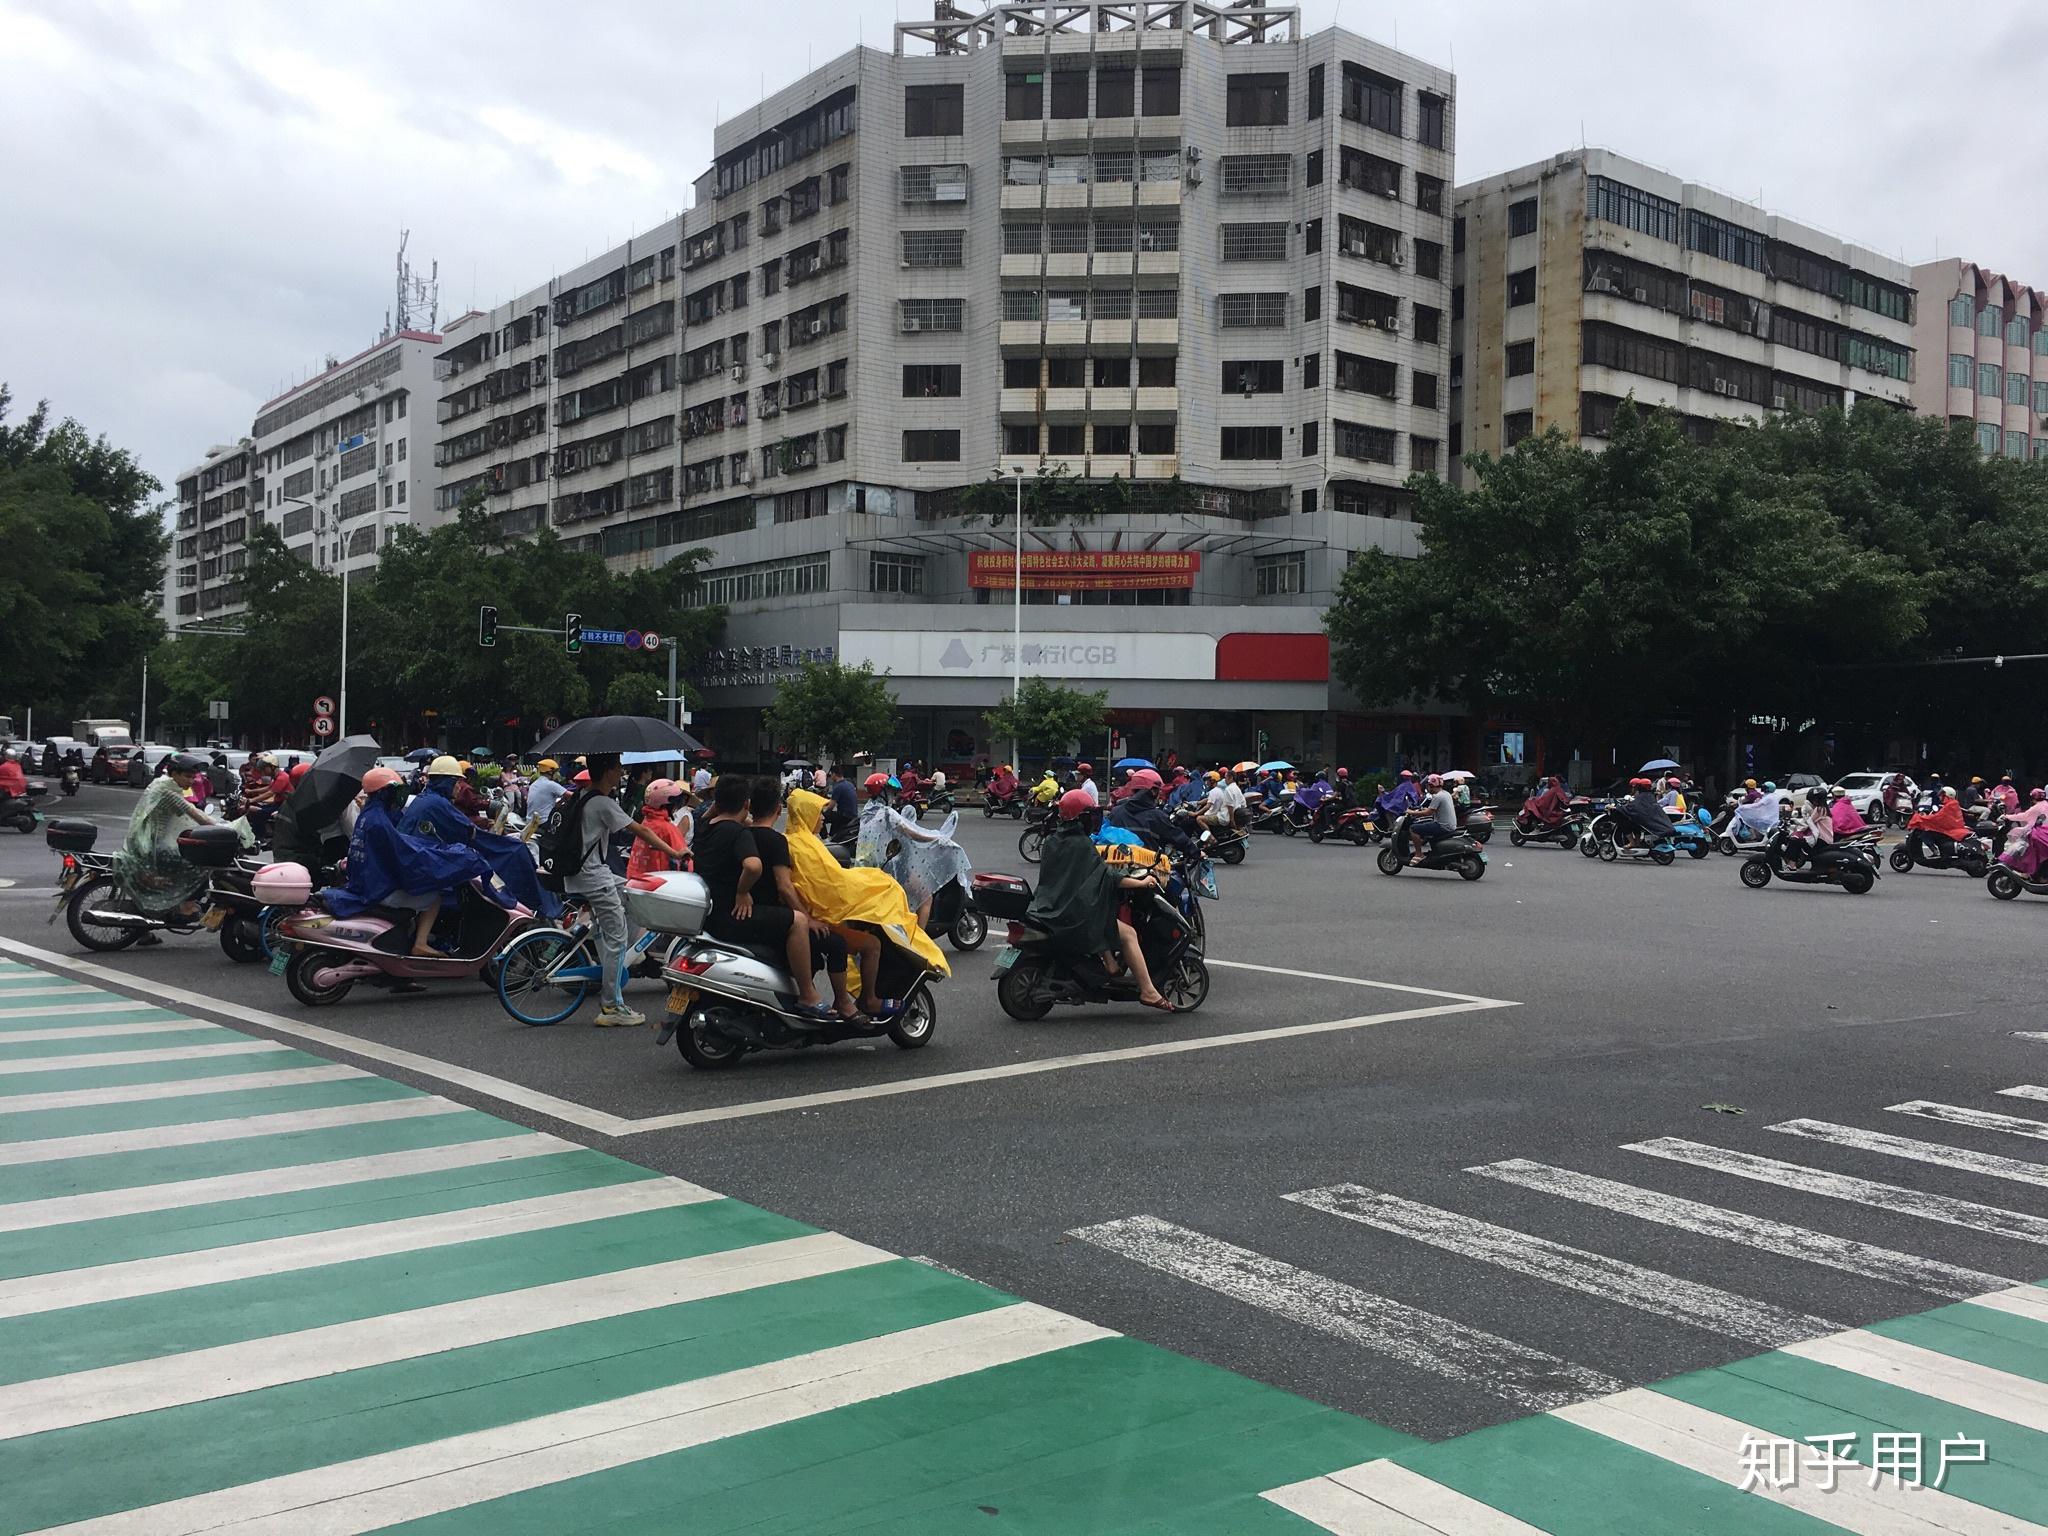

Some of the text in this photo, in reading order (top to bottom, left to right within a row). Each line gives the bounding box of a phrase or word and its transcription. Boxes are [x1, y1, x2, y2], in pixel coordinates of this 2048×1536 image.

[976, 554, 1193, 569] 积极投身新时中国特色社会主义伟大实践，凝聚同心共筑中国梦的磅礴力量！
[646, 636, 657, 647] 40
[546, 718, 557, 729] 40
